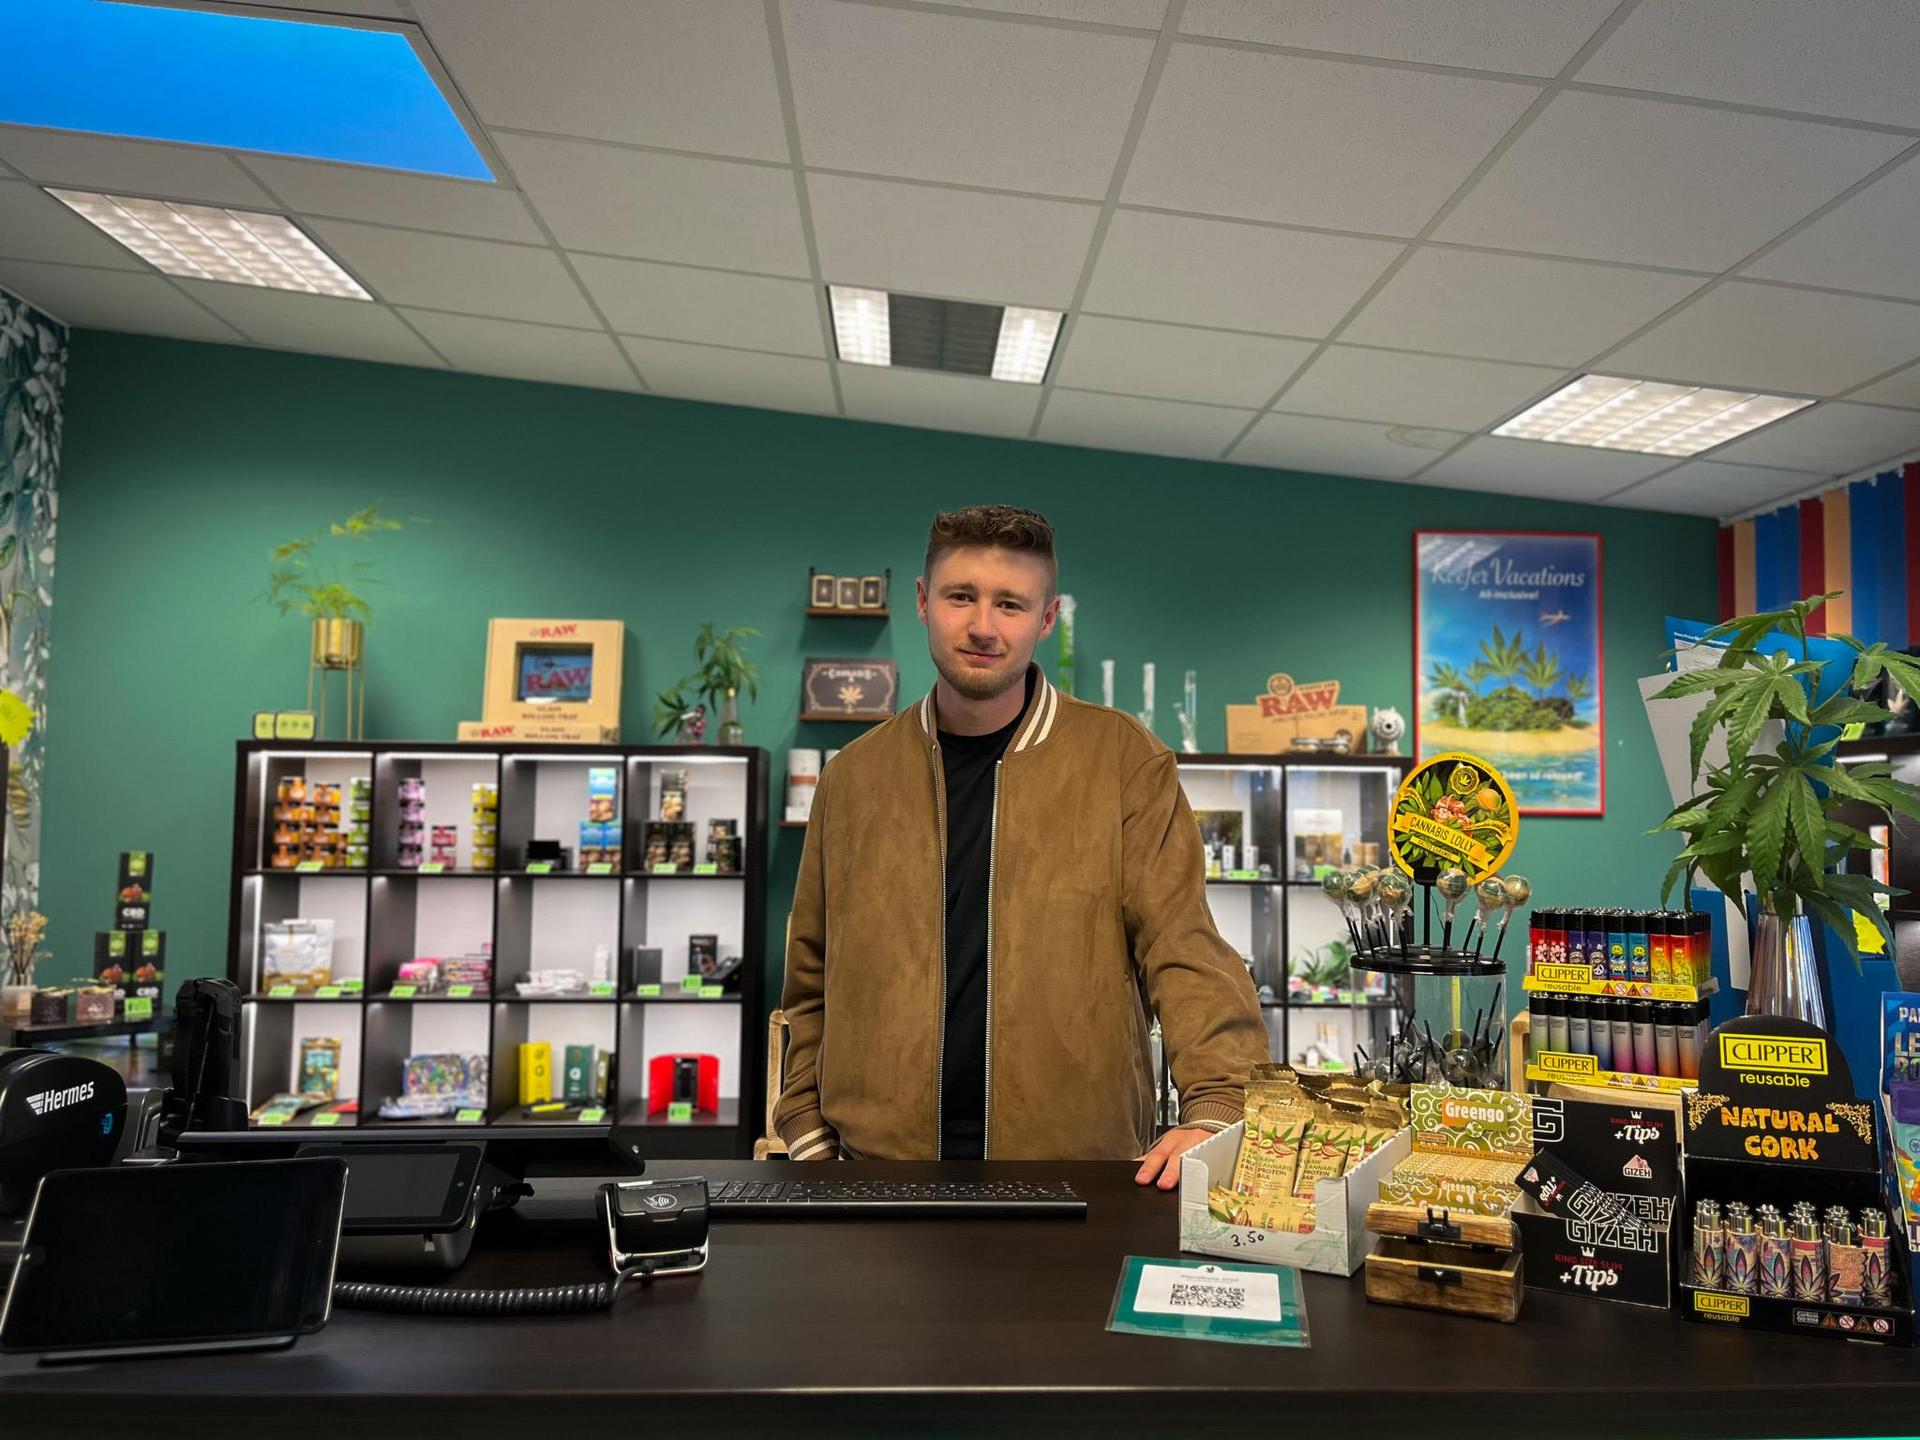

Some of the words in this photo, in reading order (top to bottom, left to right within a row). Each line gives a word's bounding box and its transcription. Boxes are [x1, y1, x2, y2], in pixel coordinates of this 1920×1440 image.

[1432, 563, 1488, 591] Keefer
[1491, 558, 1585, 587] Vacations
[539, 624, 578, 638] RAW
[527, 667, 592, 692] RAW
[1259, 688, 1337, 718] RAW
[480, 726, 515, 738] RAW
[1410, 816, 1449, 840] CANNABIS
[1450, 833, 1476, 853] LOLLY
[122, 907, 146, 917] CBD
[1541, 968, 1586, 981] CLIPPER
[1544, 983, 1582, 992] reusable
[1732, 1043, 1814, 1064] CLIPPER
[1544, 1057, 1589, 1071] CLIPPER
[1740, 1073, 1810, 1087] reusable
[44, 1081, 94, 1113] Hermes
[1445, 1101, 1504, 1122] Greengo
[1721, 1106, 1839, 1133] NATURAL
[1745, 1135, 1819, 1160] CORK
[1258, 1168, 1287, 1176] PROTEIN
[1303, 1169, 1330, 1177] PROTEIN
[1624, 1168, 1651, 1178] GIZEH
[1231, 1231, 1264, 1247] 3.50
[1554, 1253, 1578, 1264] KING
[1580, 1257, 1599, 1268] SIZE
[1600, 1261, 1624, 1271] SLIM
[1700, 1296, 1742, 1311] CLIPPER
[1703, 1312, 1740, 1323] reusable
